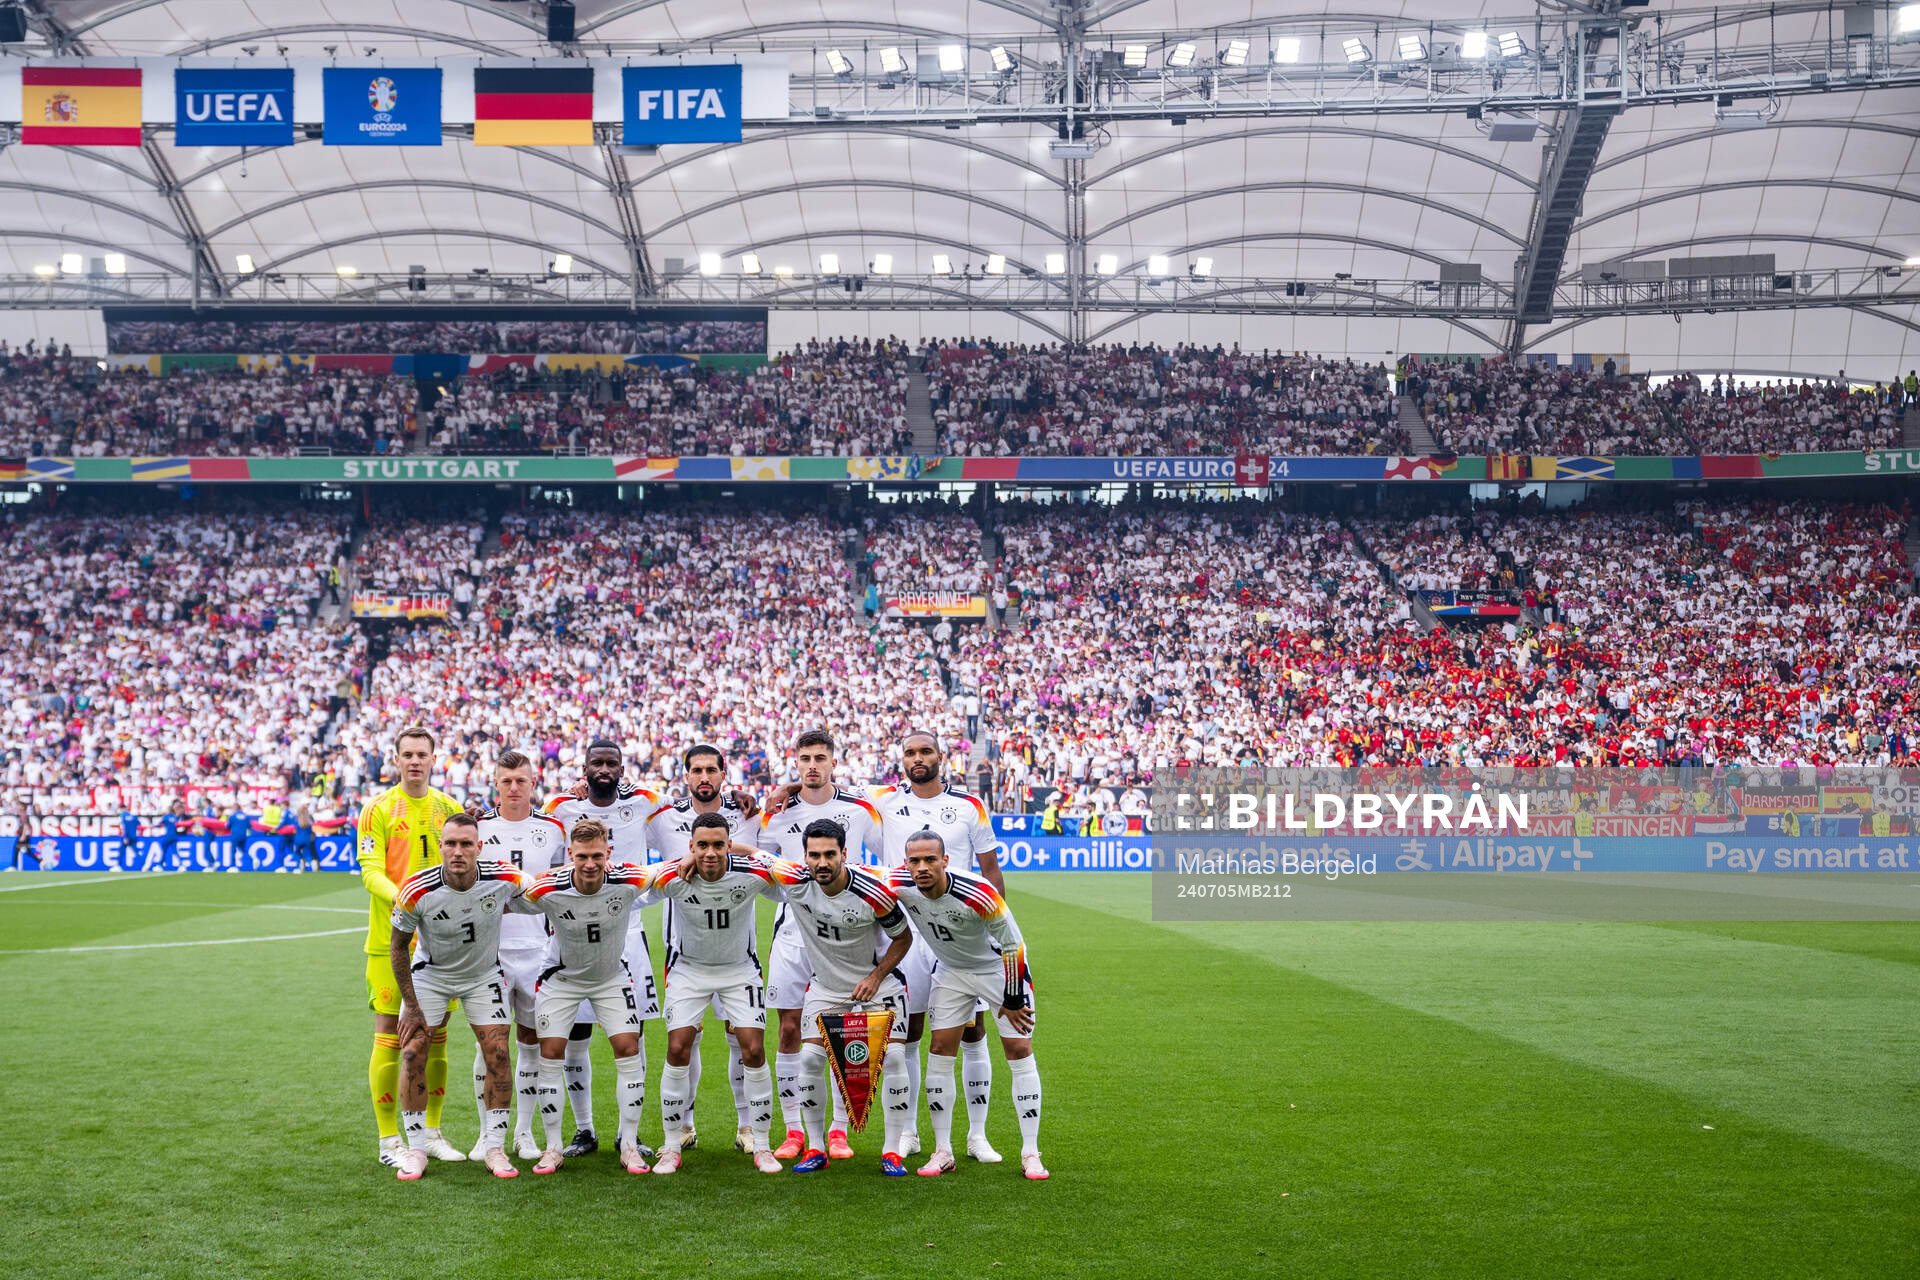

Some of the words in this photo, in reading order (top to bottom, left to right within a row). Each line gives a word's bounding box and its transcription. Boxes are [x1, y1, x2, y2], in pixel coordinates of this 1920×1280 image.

[186, 93, 283, 121] UEFA
[638, 88, 726, 120] FIFA
[343, 460, 520, 478] STUTTGART
[1744, 794, 1818, 809] DARMSTADT
[1001, 816, 1026, 830] 54
[419, 834, 428, 858] 1
[1060, 841, 1165, 868] million
[1706, 841, 1766, 872] Pay
[1774, 843, 1869, 869] smart
[1877, 843, 1909, 869] at
[704, 908, 730, 930] 10
[461, 922, 476, 944] 3
[587, 923, 602, 943] 6
[816, 920, 842, 941] 21
[927, 921, 955, 942] 19
[488, 983, 503, 1004] 3
[645, 975, 657, 999] 2
[622, 987, 637, 1010] 6
[889, 1086, 909, 1095] DFB
[1017, 1093, 1039, 1101] DFB
